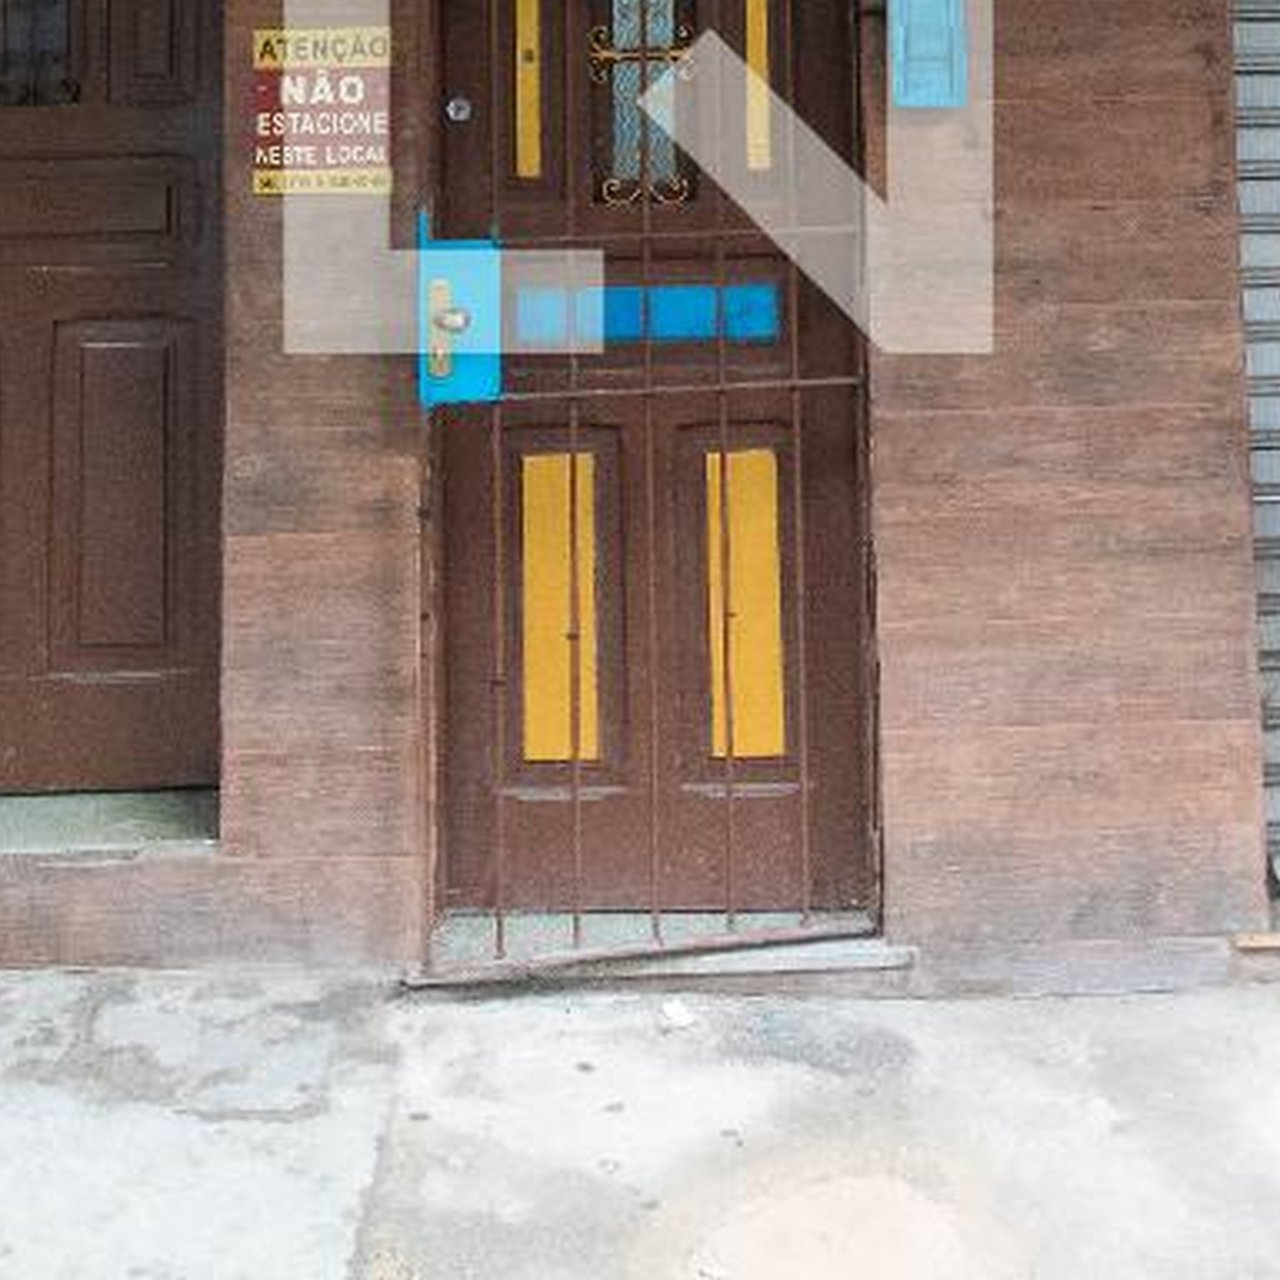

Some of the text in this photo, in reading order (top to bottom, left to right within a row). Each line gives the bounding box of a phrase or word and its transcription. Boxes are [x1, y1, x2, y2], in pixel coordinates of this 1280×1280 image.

[258, 34, 389, 63] ATENÇÃO
[281, 69, 365, 104] NÃO
[256, 111, 389, 136] ESTACIONE
[255, 144, 387, 166] NESTE LOCAL
